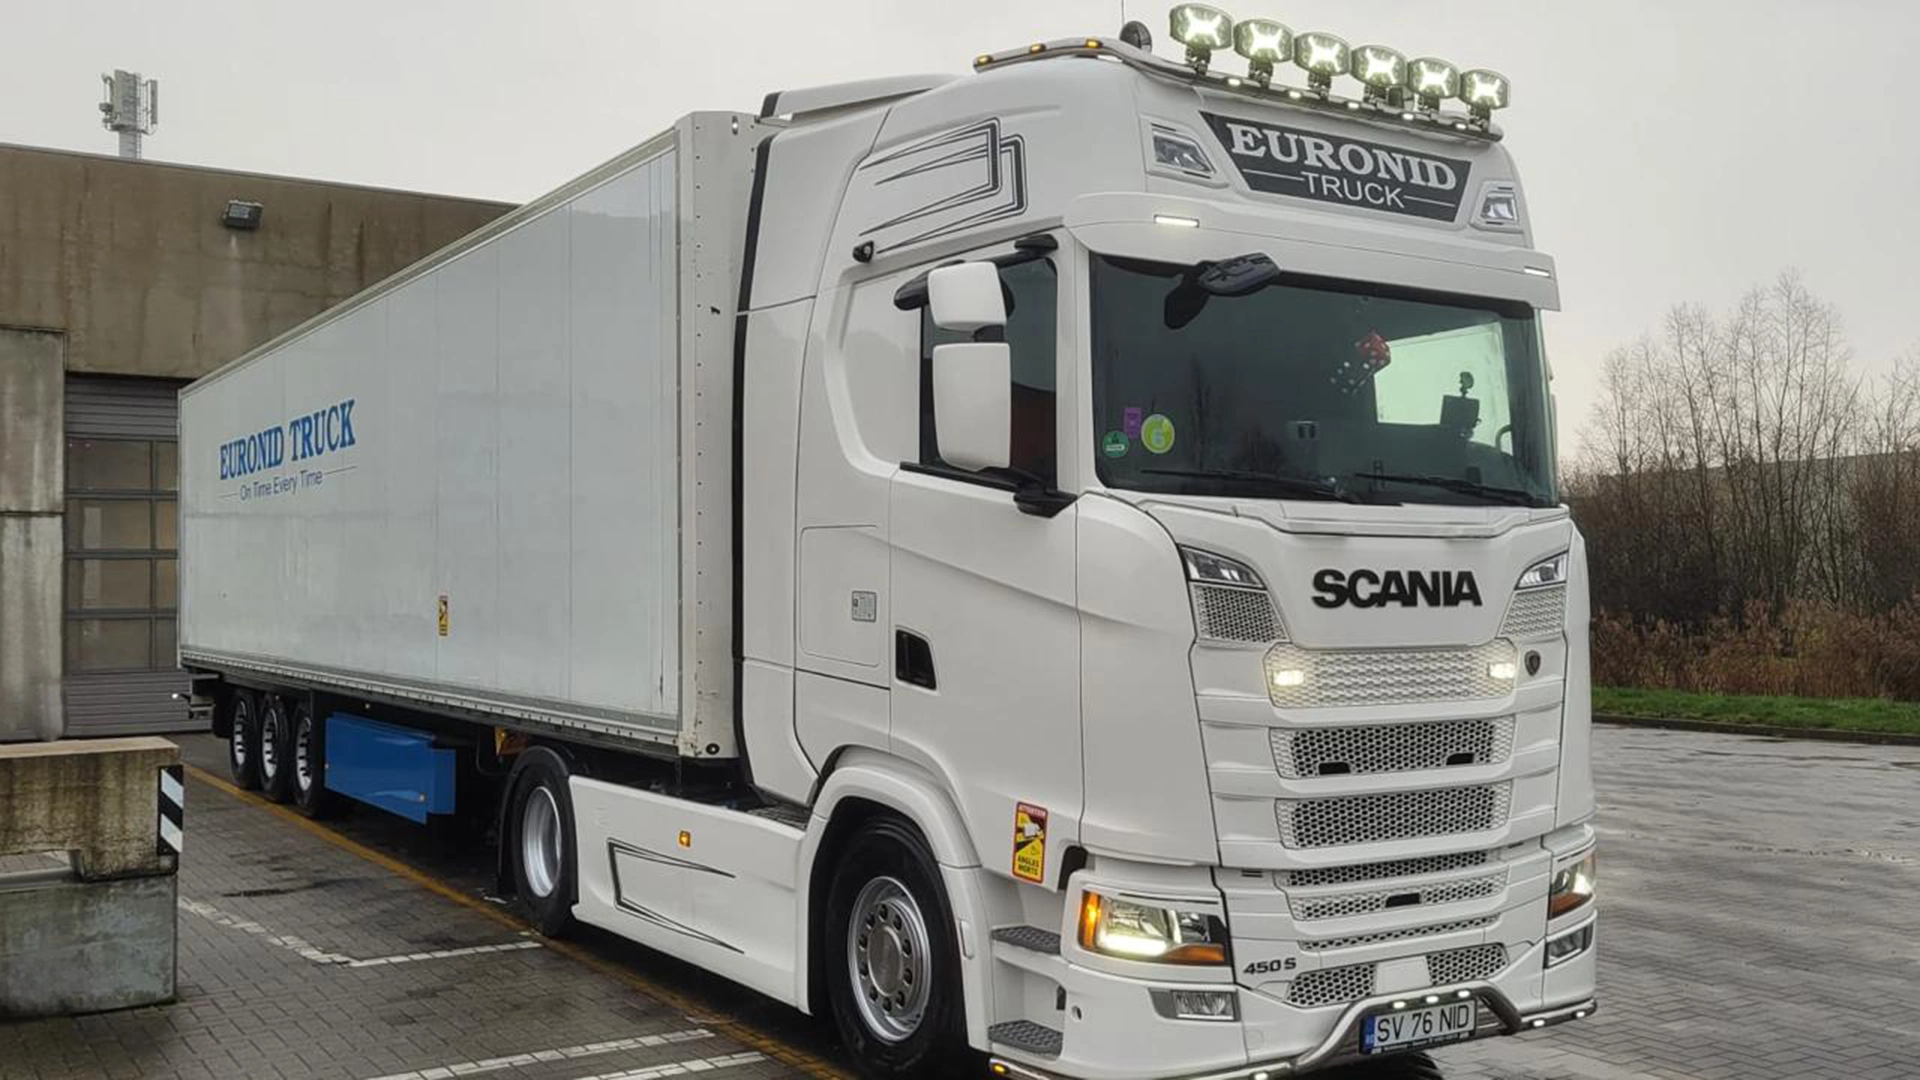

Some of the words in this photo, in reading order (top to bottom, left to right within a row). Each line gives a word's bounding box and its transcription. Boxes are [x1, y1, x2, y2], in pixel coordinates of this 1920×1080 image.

[1226, 122, 1456, 190] EURONID
[1301, 171, 1405, 208] TRUCK
[219, 425, 284, 480] EURONID
[289, 399, 356, 461] TRUCK
[240, 484, 252, 501] On
[253, 481, 272, 498] Time
[273, 476, 297, 495] Every
[300, 469, 323, 488] Time
[1311, 568, 1483, 609] SCANIA
[1243, 959, 1281, 974] 450
[1284, 957, 1297, 970] S
[1377, 1015, 1404, 1043] SV
[1412, 1011, 1433, 1037] 76
[1439, 1004, 1469, 1033] NID
